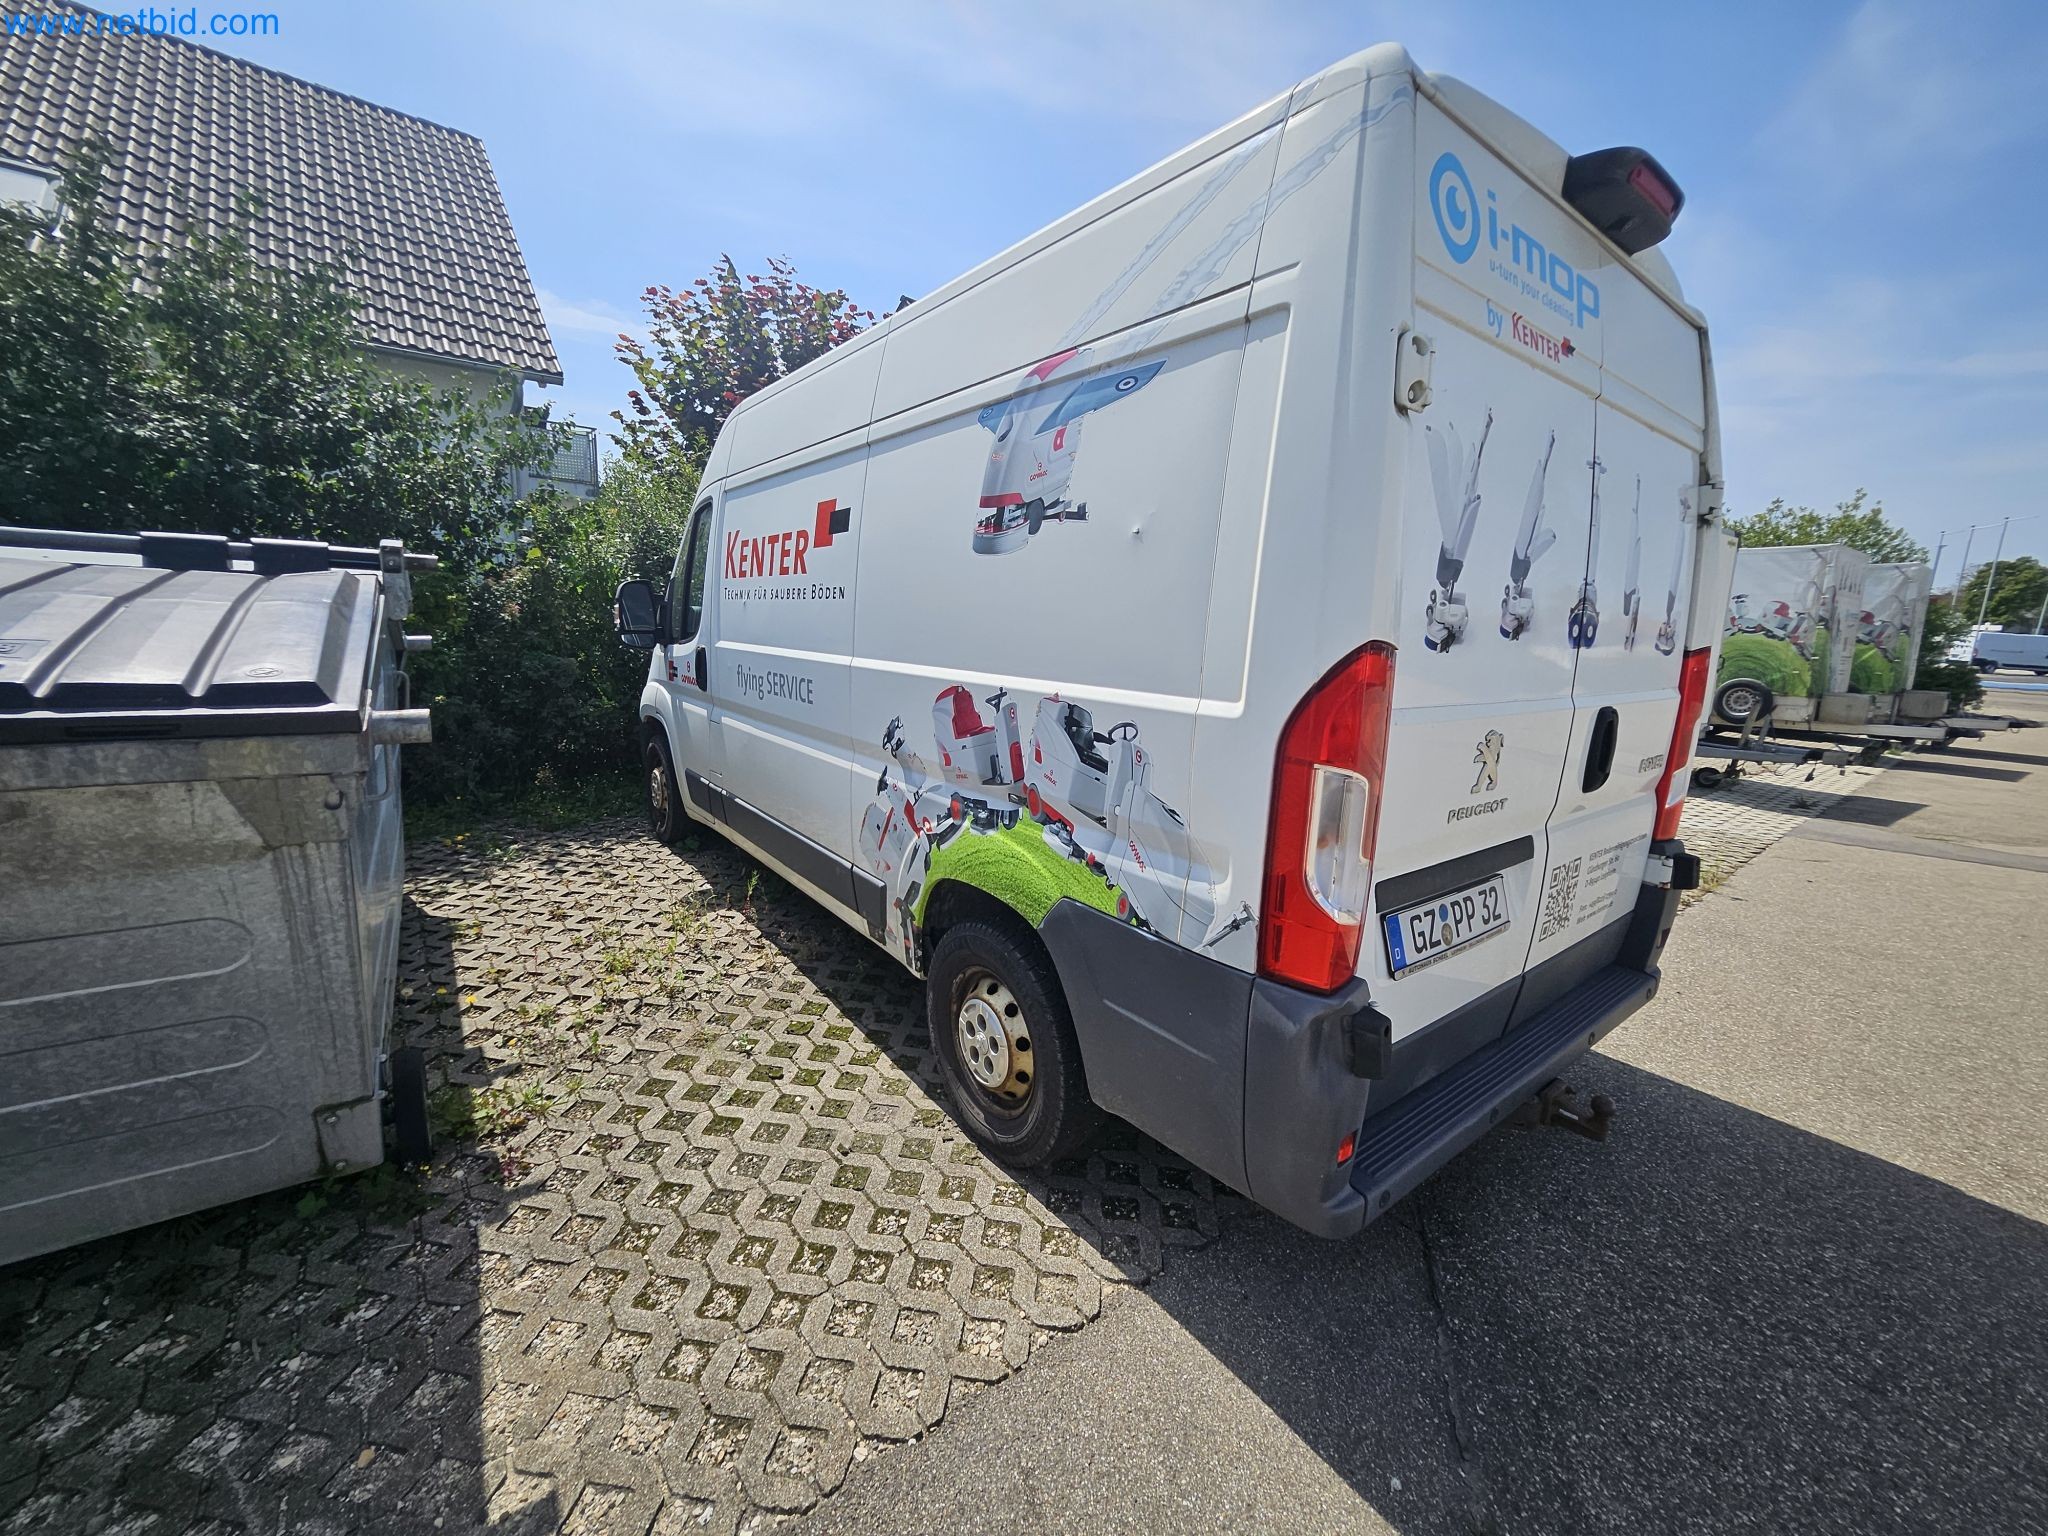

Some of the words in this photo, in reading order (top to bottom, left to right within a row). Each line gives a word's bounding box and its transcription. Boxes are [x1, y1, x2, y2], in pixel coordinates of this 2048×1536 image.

[1487, 188, 1600, 329] i-mop
[1489, 259, 1519, 288] u-turn
[1520, 279, 1540, 300] your
[1486, 298, 1503, 338] by
[1511, 311, 1561, 363] KENTER
[724, 529, 810, 579] KENTER
[770, 587, 807, 600] SAUBERE
[811, 583, 846, 600] BÖDEN
[737, 663, 764, 701] flying
[766, 670, 814, 705] SERVICE
[1447, 797, 1508, 825] PEUGEOT
[1409, 908, 1442, 955] GZ
[1450, 895, 1476, 938] PP
[1478, 885, 1502, 926] 32
